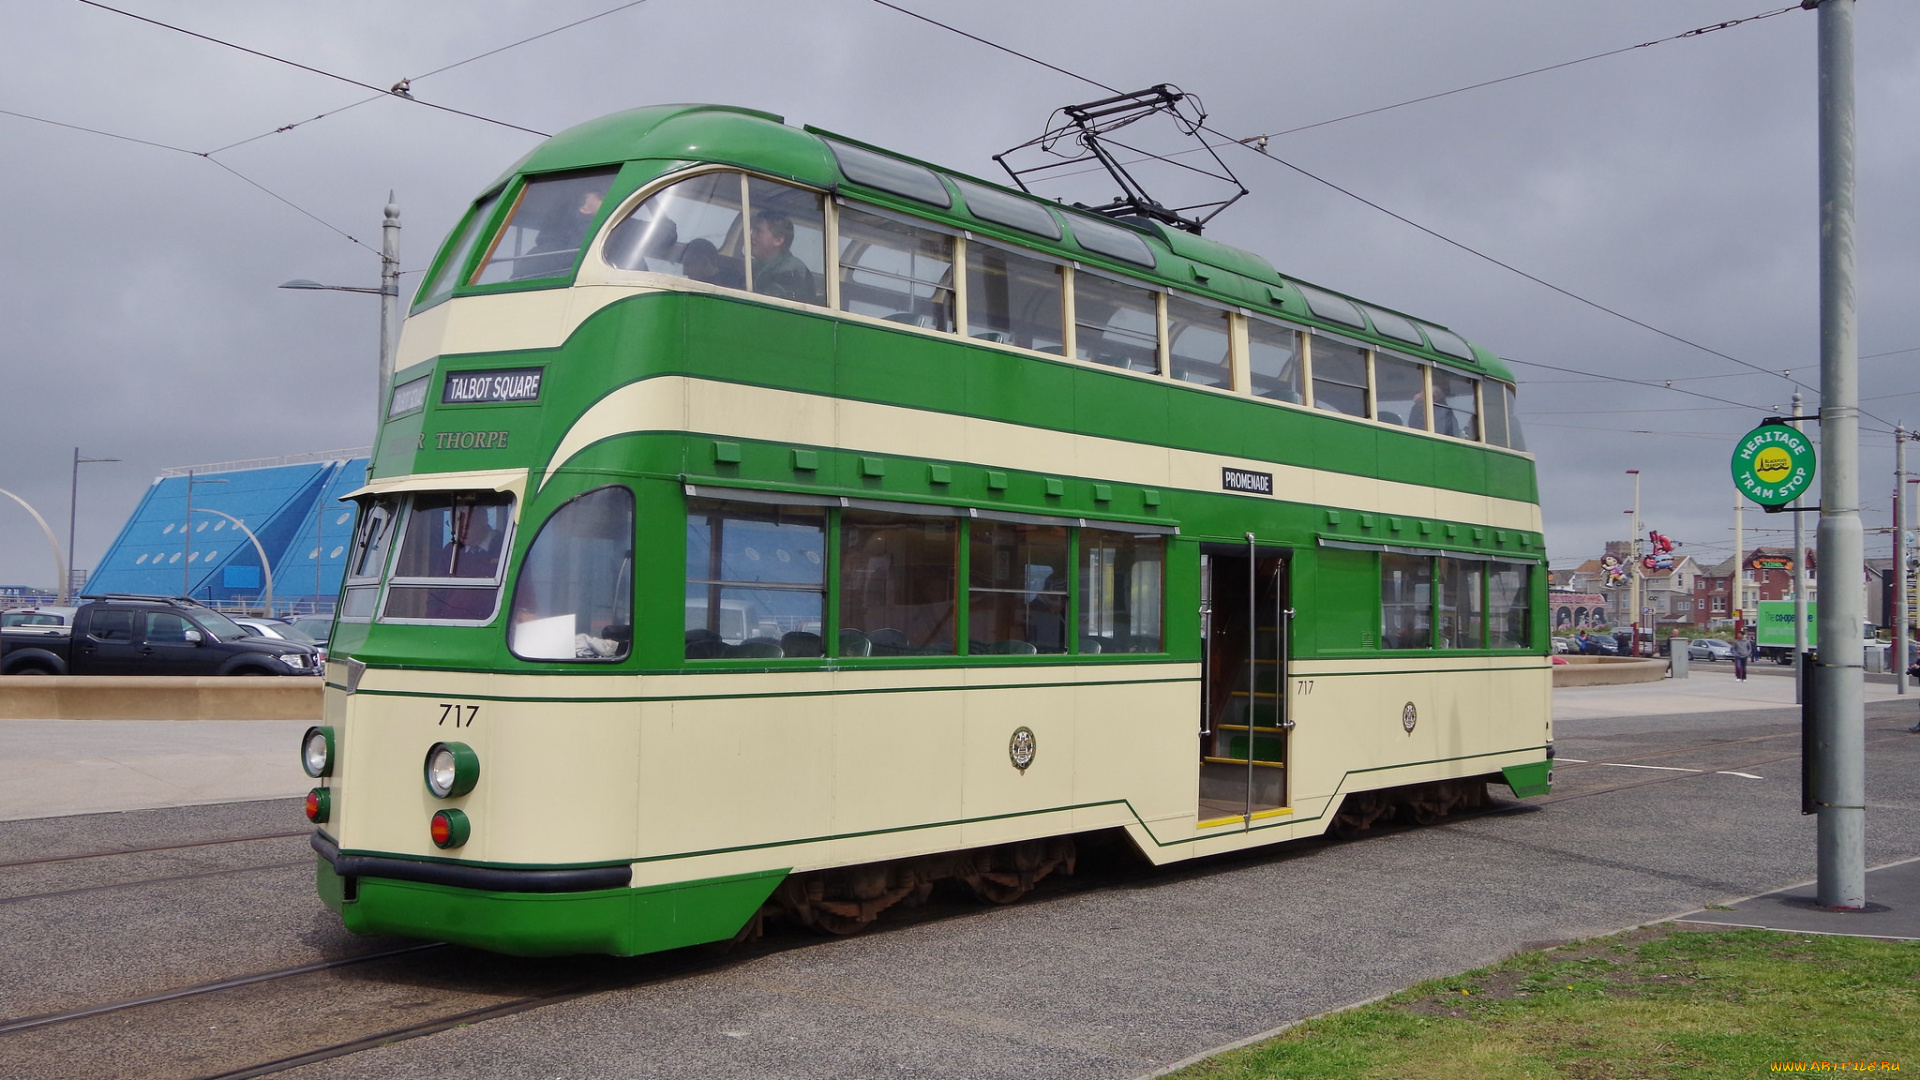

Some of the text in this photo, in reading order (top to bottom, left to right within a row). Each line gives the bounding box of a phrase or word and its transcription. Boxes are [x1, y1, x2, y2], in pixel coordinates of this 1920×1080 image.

[451, 377, 492, 400] TALBOT
[493, 375, 540, 400] SQUARE
[436, 431, 509, 449] THORPE
[1740, 431, 1806, 460] HERITAGE
[1225, 471, 1270, 492] PROMENADE
[1740, 467, 1806, 499] TRAM STOP
[1298, 680, 1314, 695] 717
[439, 703, 480, 728] 717
